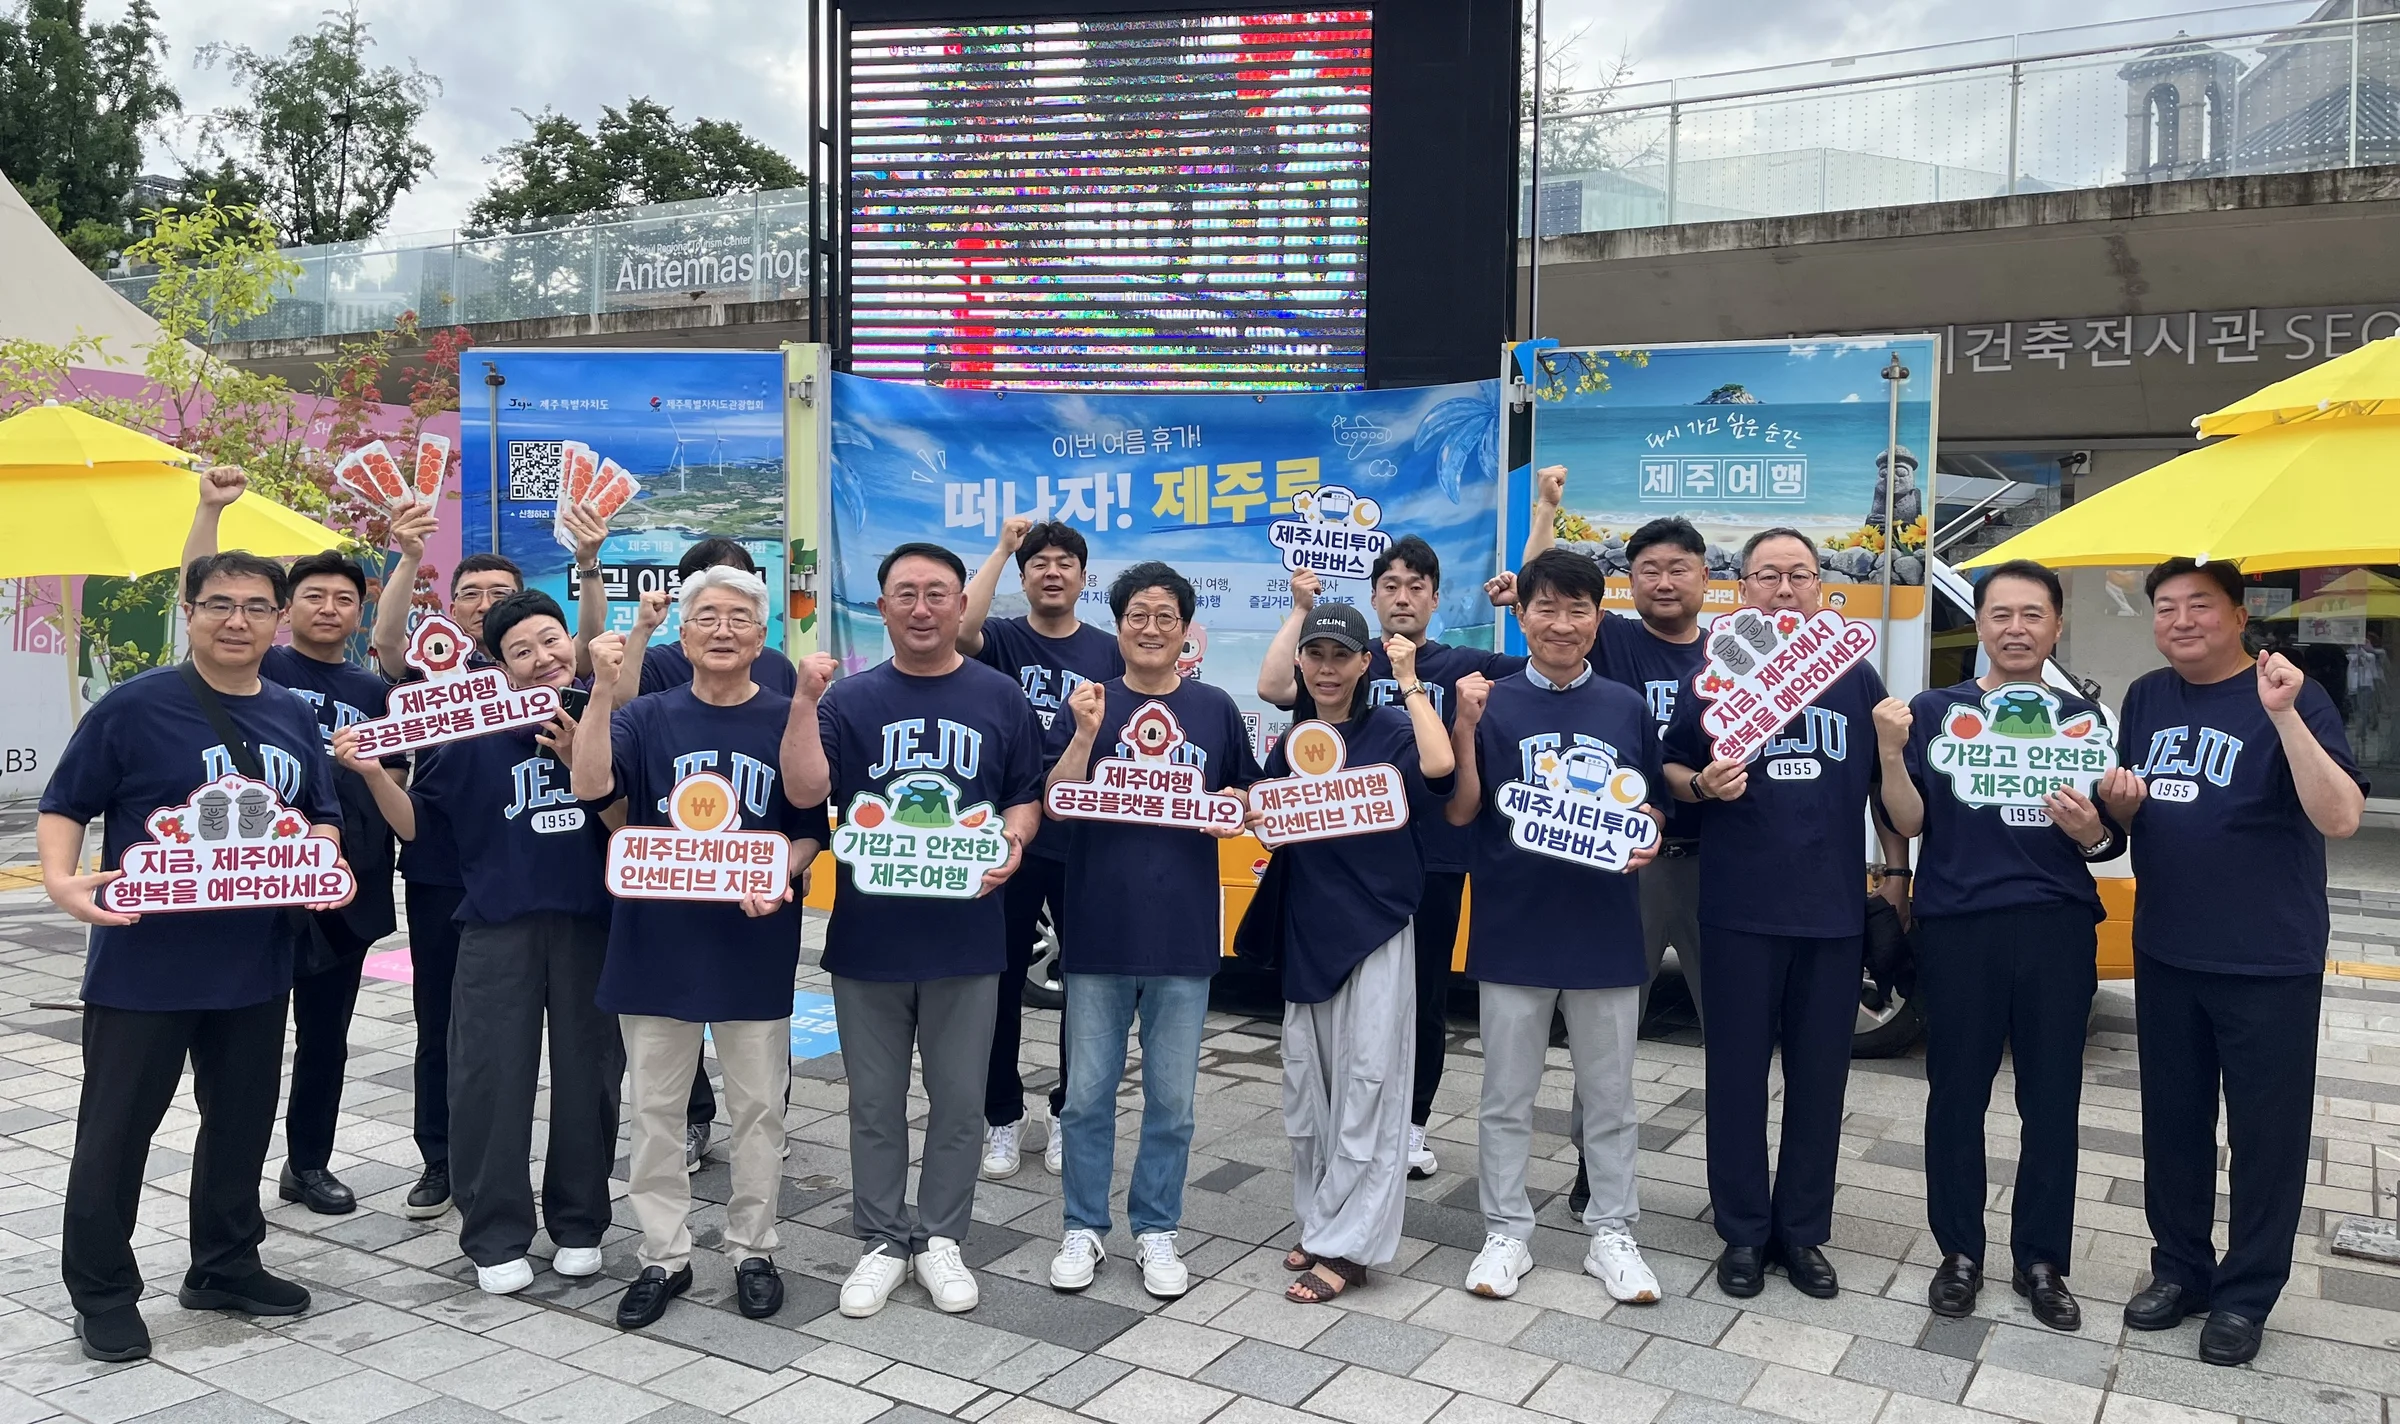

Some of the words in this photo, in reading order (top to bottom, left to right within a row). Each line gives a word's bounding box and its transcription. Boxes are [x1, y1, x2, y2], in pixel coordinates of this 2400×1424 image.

[656, 240, 691, 255] Regional
[692, 238, 723, 250] Tourism
[723, 235, 752, 247] Center
[615, 243, 809, 292] Antennashop
[1922, 309, 2265, 375] 건축전시관
[508, 398, 532, 411] Jeju
[540, 399, 610, 411] 제주특별자치도
[666, 399, 764, 411] 제주특별자치도관광협회
[1052, 432, 1096, 459] 이번
[1102, 429, 1147, 456] 여름
[1150, 424, 1202, 454] 휴가!
[1644, 425, 1681, 449] 다시
[1686, 416, 1721, 436] 가고
[1726, 411, 1760, 440] 싶은
[1764, 422, 1803, 449] 순간
[1644, 463, 1802, 494] 제주여행
[944, 471, 1133, 537] 떠나자!
[1151, 456, 1321, 525] 제주로
[519, 509, 550, 519] 신청하러
[1275, 524, 1386, 554] 제주시티투어
[1291, 549, 1366, 574] 야밤버스
[1206, 577, 1231, 593] 여행,
[1266, 579, 1292, 592] 관광
[1249, 595, 1293, 609] 즐길거리
[1316, 618, 1347, 628] CELINE
[1711, 686, 1763, 730] 지금,
[1754, 618, 1836, 692] 제주에서
[398, 675, 499, 716] 제주여행
[1716, 705, 1781, 761] 행복을
[1773, 627, 1871, 714] 예약하세요
[357, 708, 476, 752] 공공플랫폼
[480, 691, 555, 727] 탐나오
[1745, 706, 1848, 766] EJU
[868, 718, 982, 780] JEJU
[1941, 742, 2018, 769] 가깝고
[2027, 746, 2108, 774] 안전한
[2131, 725, 2244, 788] JEJU
[1104, 765, 1194, 795] 제주여행
[1776, 762, 1812, 776] 1955
[1258, 772, 1389, 811] 제주단체여행
[1969, 773, 2075, 799] 제주여행
[2156, 782, 2191, 799] 1955
[541, 812, 576, 829] 1955
[1055, 787, 1165, 818] 공공플랫폼
[1171, 798, 1237, 824] 탐나오
[1263, 807, 1348, 838] 인센티브
[1350, 799, 1396, 826] 지원
[1505, 787, 1649, 843] 제주시티투어
[2009, 808, 2046, 823] 1955
[623, 836, 775, 865] 제주단체여행
[843, 831, 917, 858] 가깝고
[926, 836, 1000, 863] 안전한
[1523, 821, 1618, 864] 야밤버스
[139, 849, 203, 875] 지금,
[211, 843, 320, 872] 제주에서
[114, 878, 198, 908] 행복을
[207, 872, 343, 902] 예약하세요
[619, 865, 717, 893] 인센티브
[724, 869, 774, 895] 지원
[869, 863, 969, 891] 제주여행
